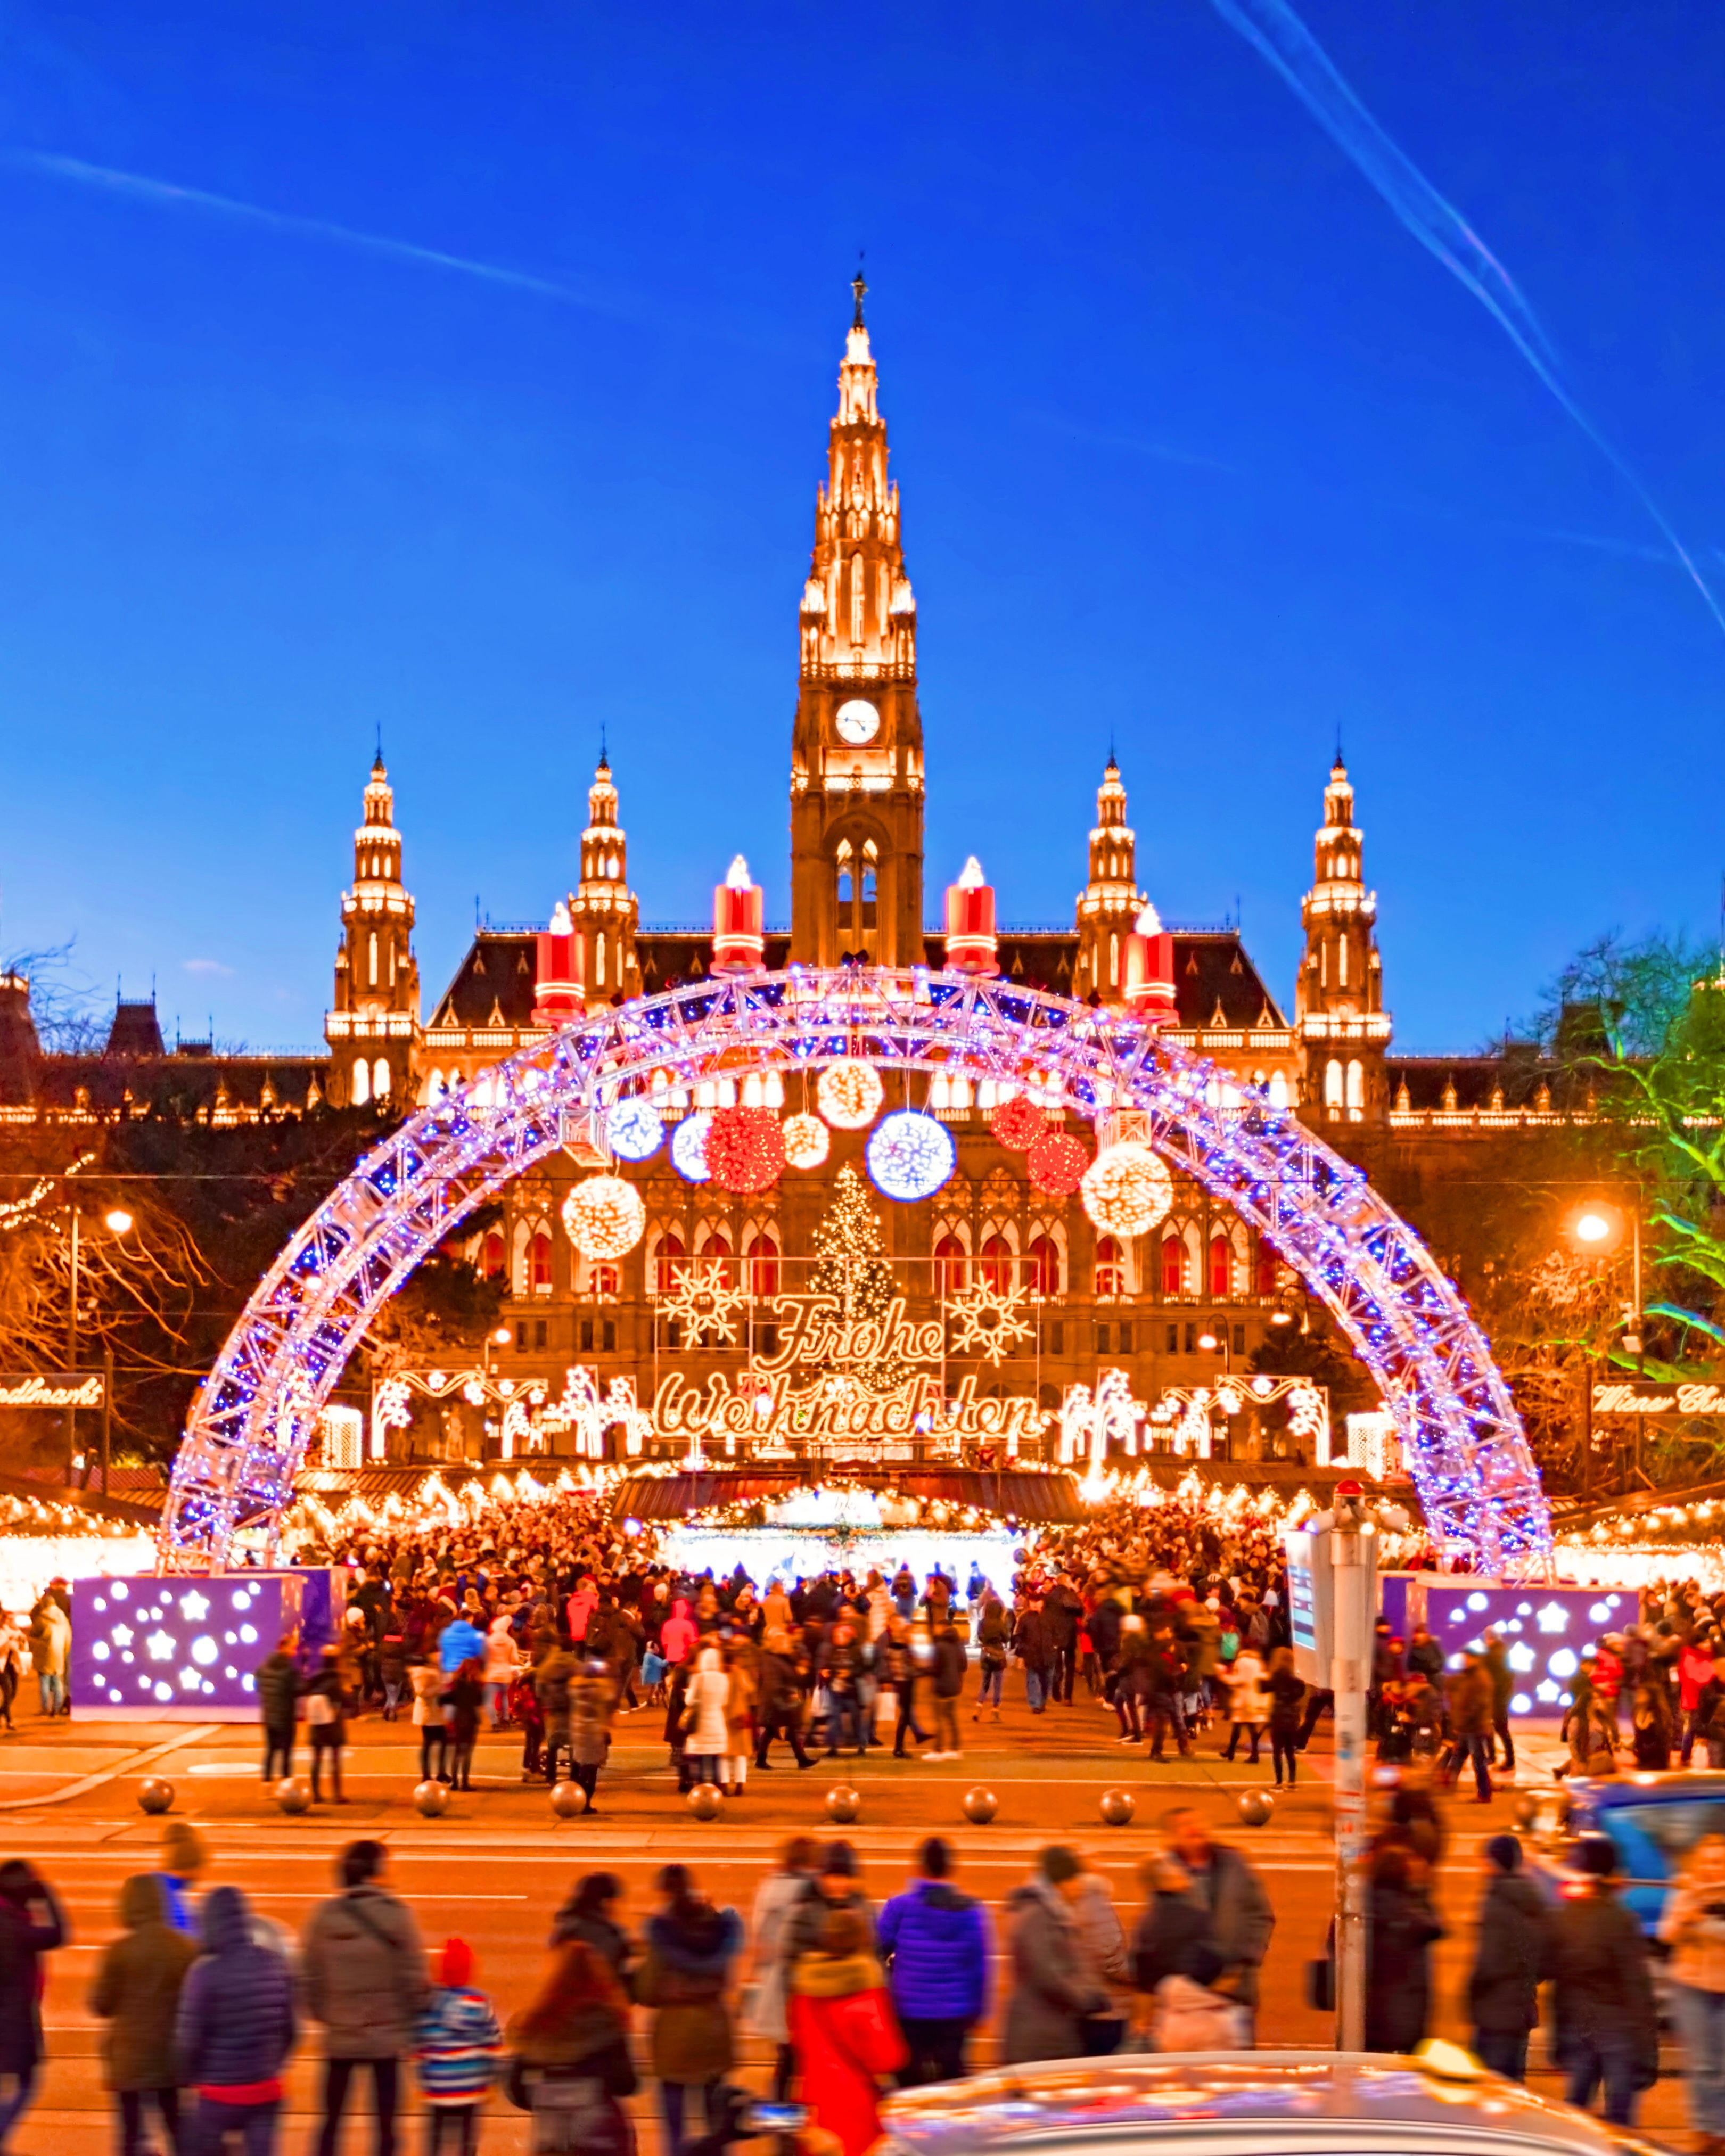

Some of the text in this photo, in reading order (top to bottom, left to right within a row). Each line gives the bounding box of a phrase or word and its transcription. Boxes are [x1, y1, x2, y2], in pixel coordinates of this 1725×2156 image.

[752, 1294, 944, 1375] Frohe
[654, 1372, 1045, 1438] Weihnachten
[1593, 1384, 1725, 1412] Wiener Chr
